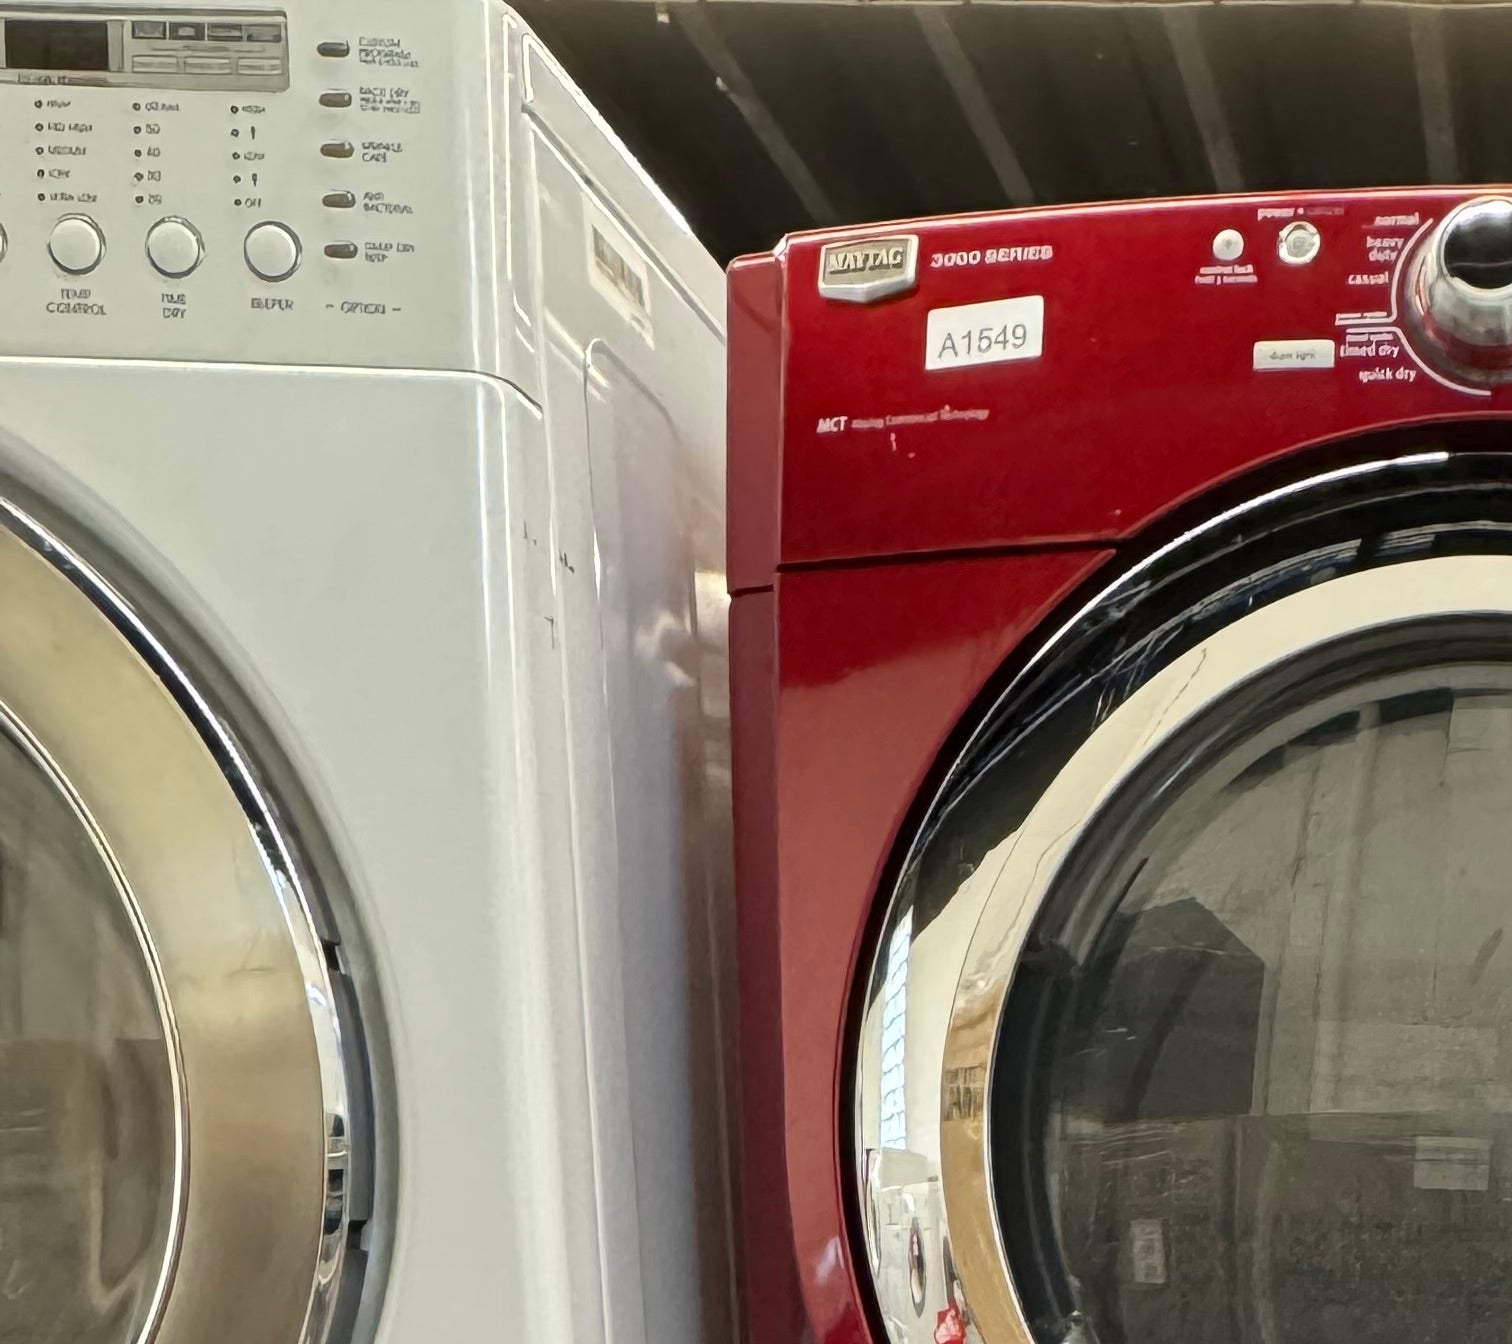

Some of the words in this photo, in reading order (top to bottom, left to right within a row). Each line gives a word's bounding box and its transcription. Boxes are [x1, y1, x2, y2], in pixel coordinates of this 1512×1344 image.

[828, 247, 904, 273] MAYTAG
[930, 250, 981, 268] 3000
[937, 323, 1028, 359] A1549
